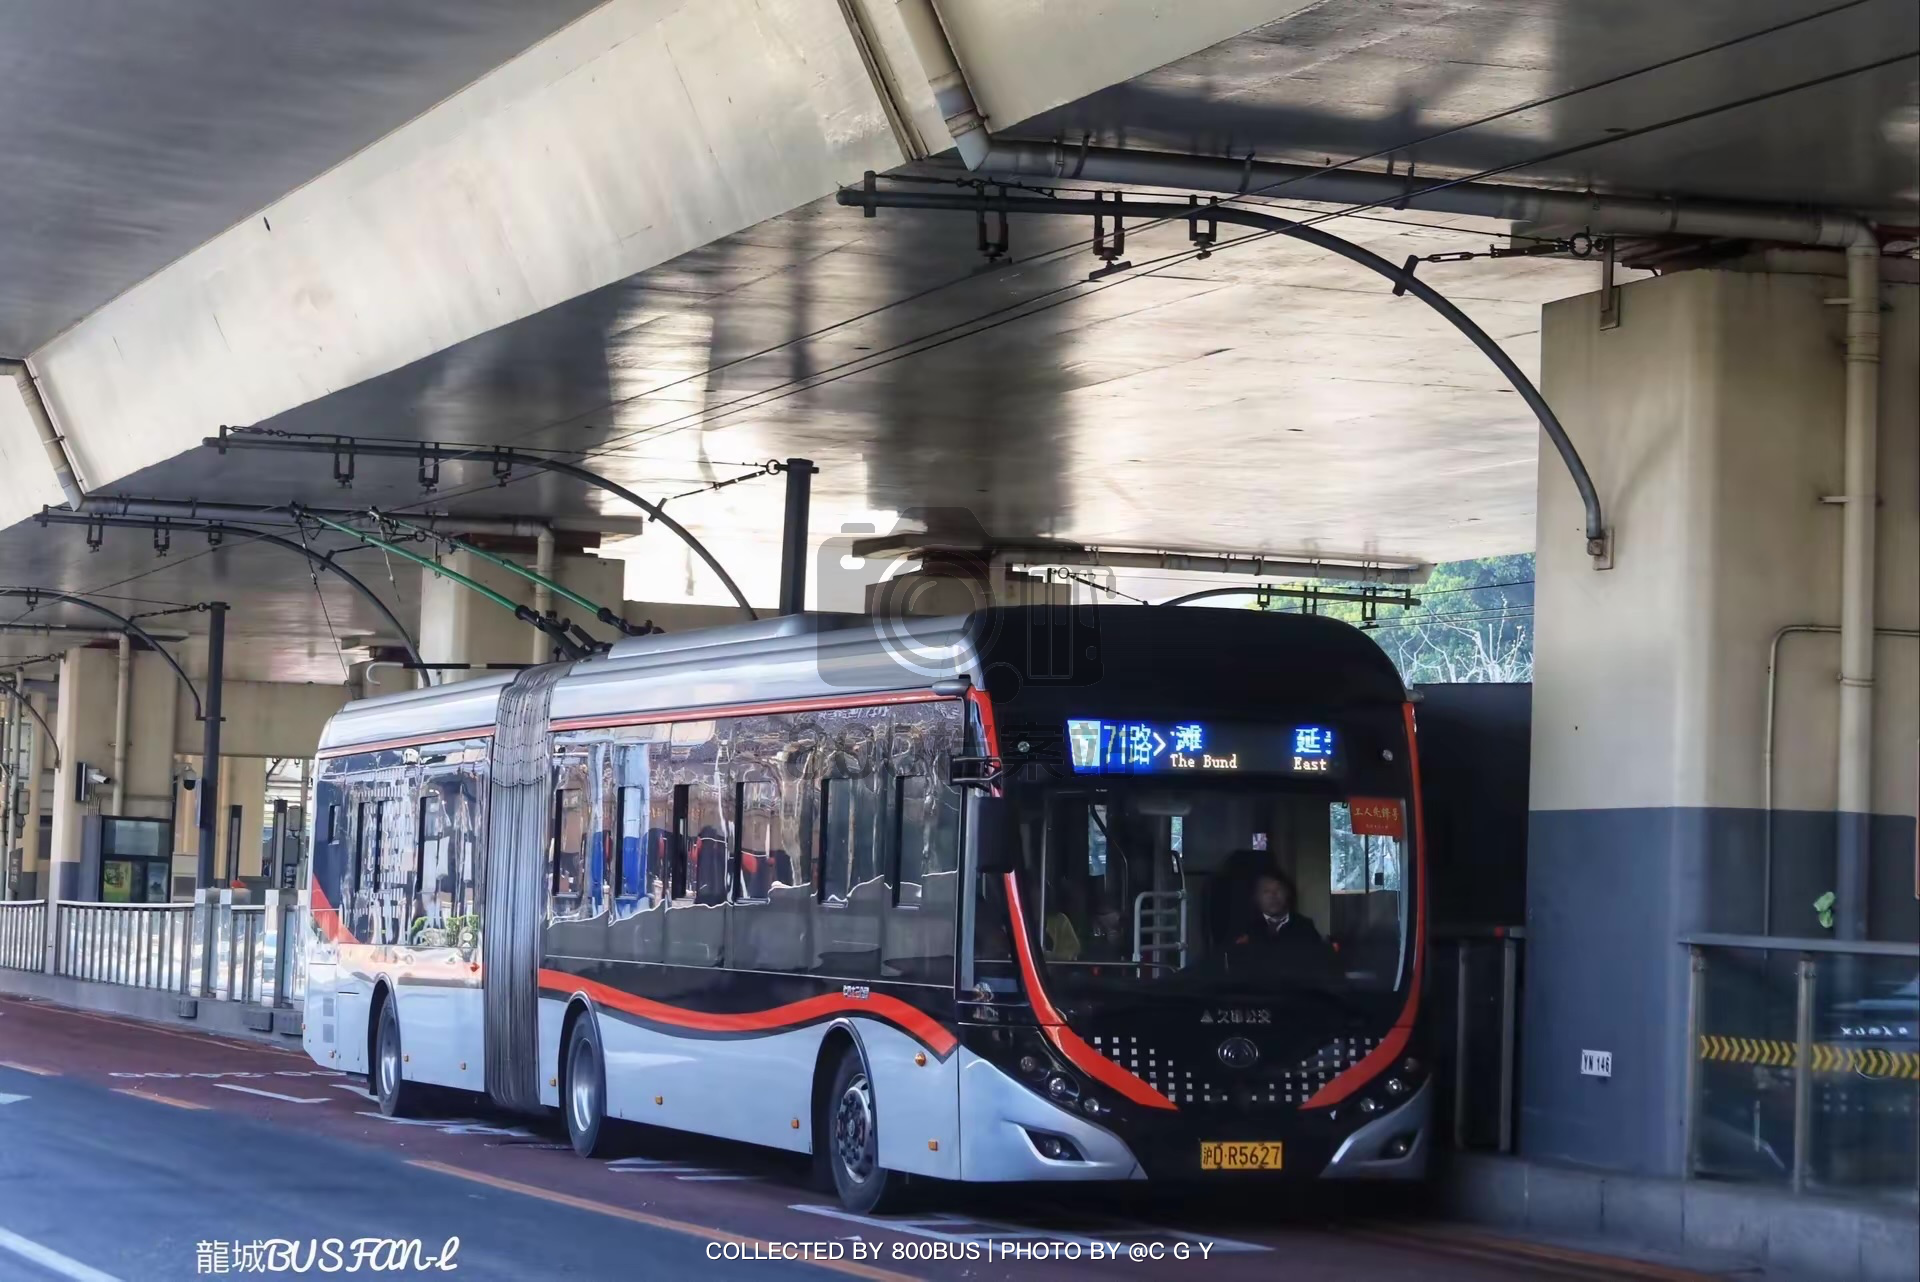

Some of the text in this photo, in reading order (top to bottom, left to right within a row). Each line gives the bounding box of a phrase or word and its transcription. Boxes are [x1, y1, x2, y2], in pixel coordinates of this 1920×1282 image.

[1170, 754, 1327, 771] The Bund East
